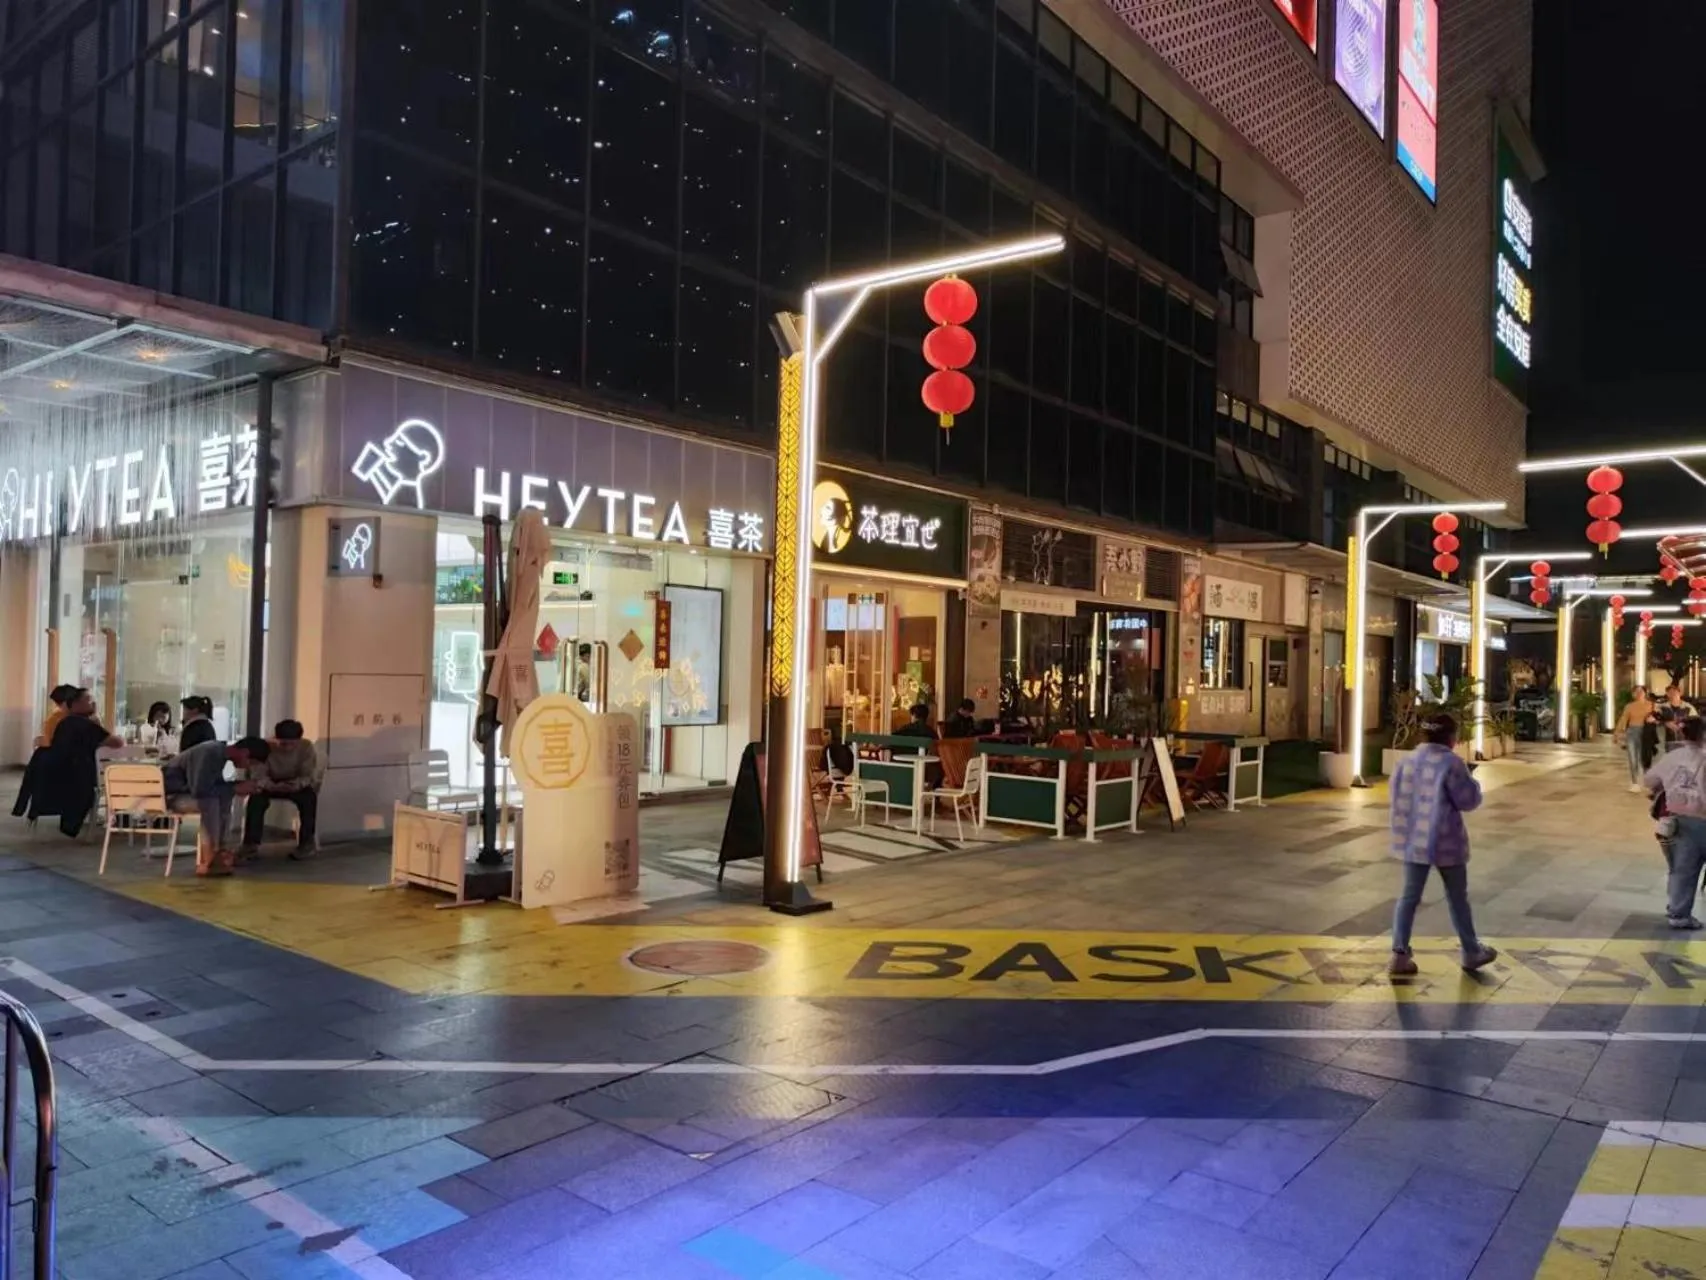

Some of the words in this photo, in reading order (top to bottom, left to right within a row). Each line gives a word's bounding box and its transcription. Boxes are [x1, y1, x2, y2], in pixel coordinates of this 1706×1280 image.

[199, 424, 258, 512] 喜茶
[474, 466, 690, 545] HEYTEA
[707, 507, 764, 553] 喜茶
[537, 719, 577, 778] 喜
